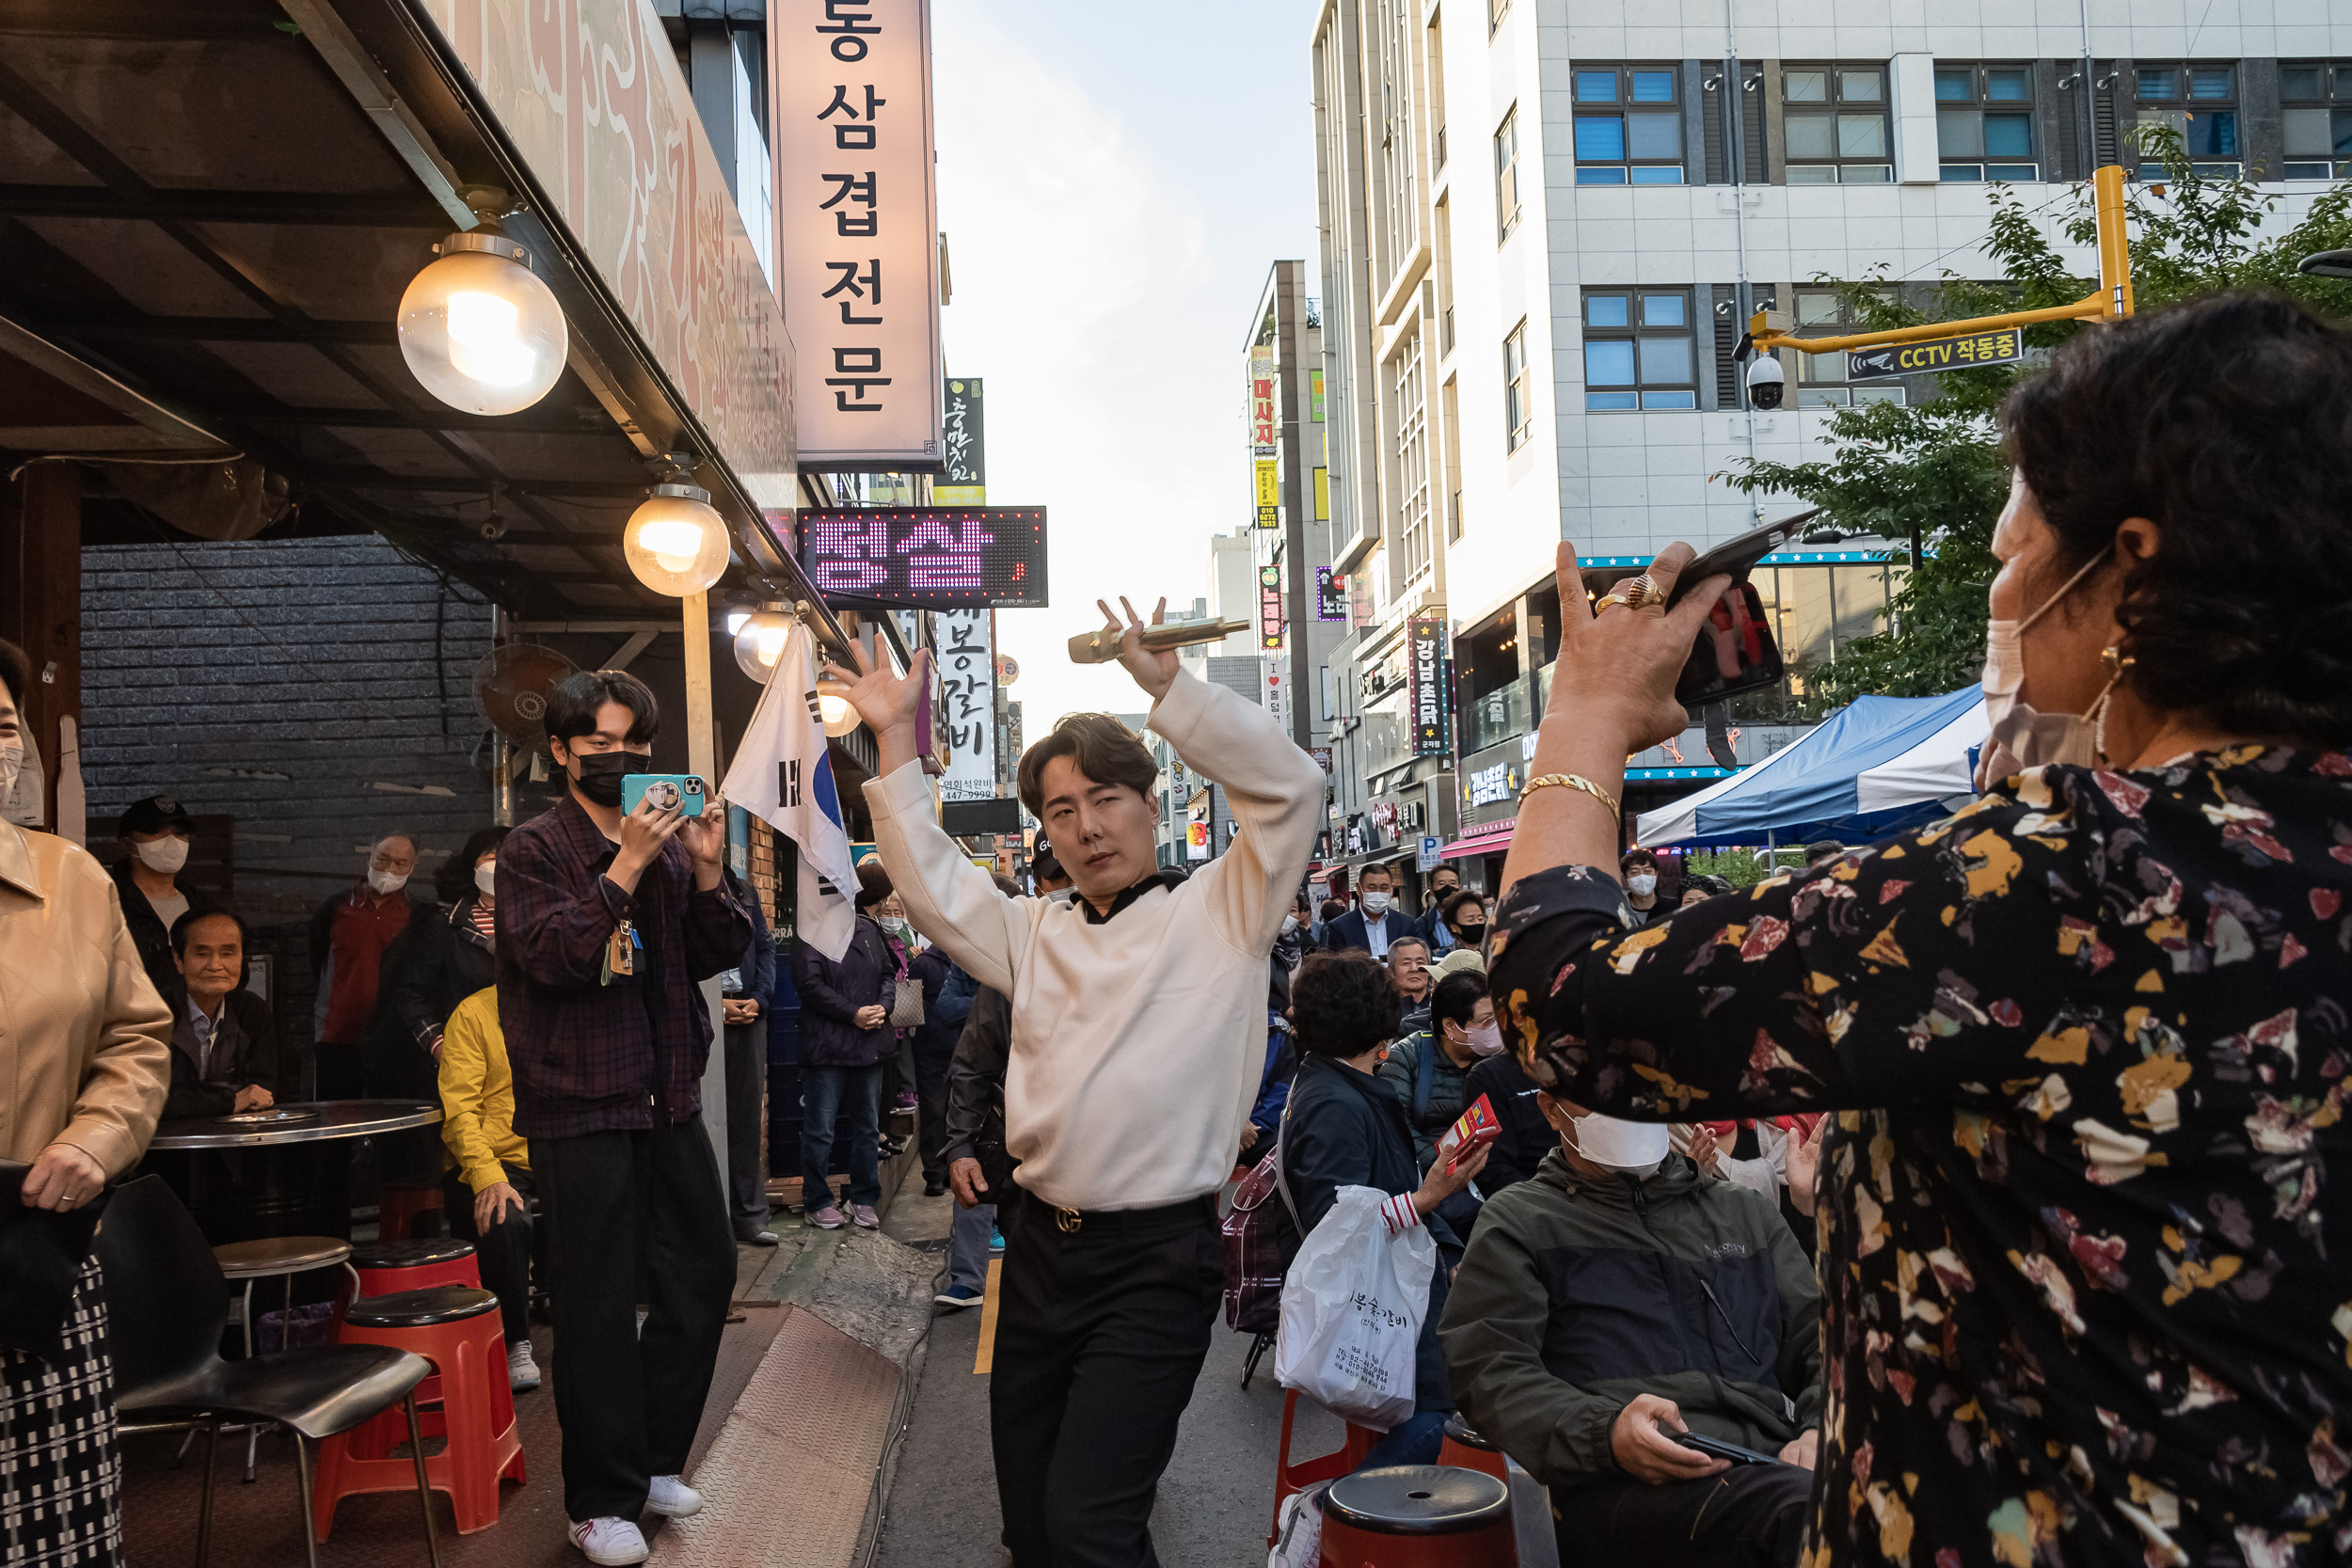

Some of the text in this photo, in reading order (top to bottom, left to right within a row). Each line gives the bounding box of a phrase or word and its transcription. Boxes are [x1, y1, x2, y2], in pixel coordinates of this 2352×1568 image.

[1252, 359, 1272, 376] 여우
[1899, 333, 2015, 369] CCTV 작동중
[1254, 379, 1273, 444] 마사지
[1263, 588, 1279, 636] 노래방
[1416, 640, 1438, 725] 강남촌닭
[946, 791, 991, 800] 447-9999
[1424, 838, 1437, 854] P
